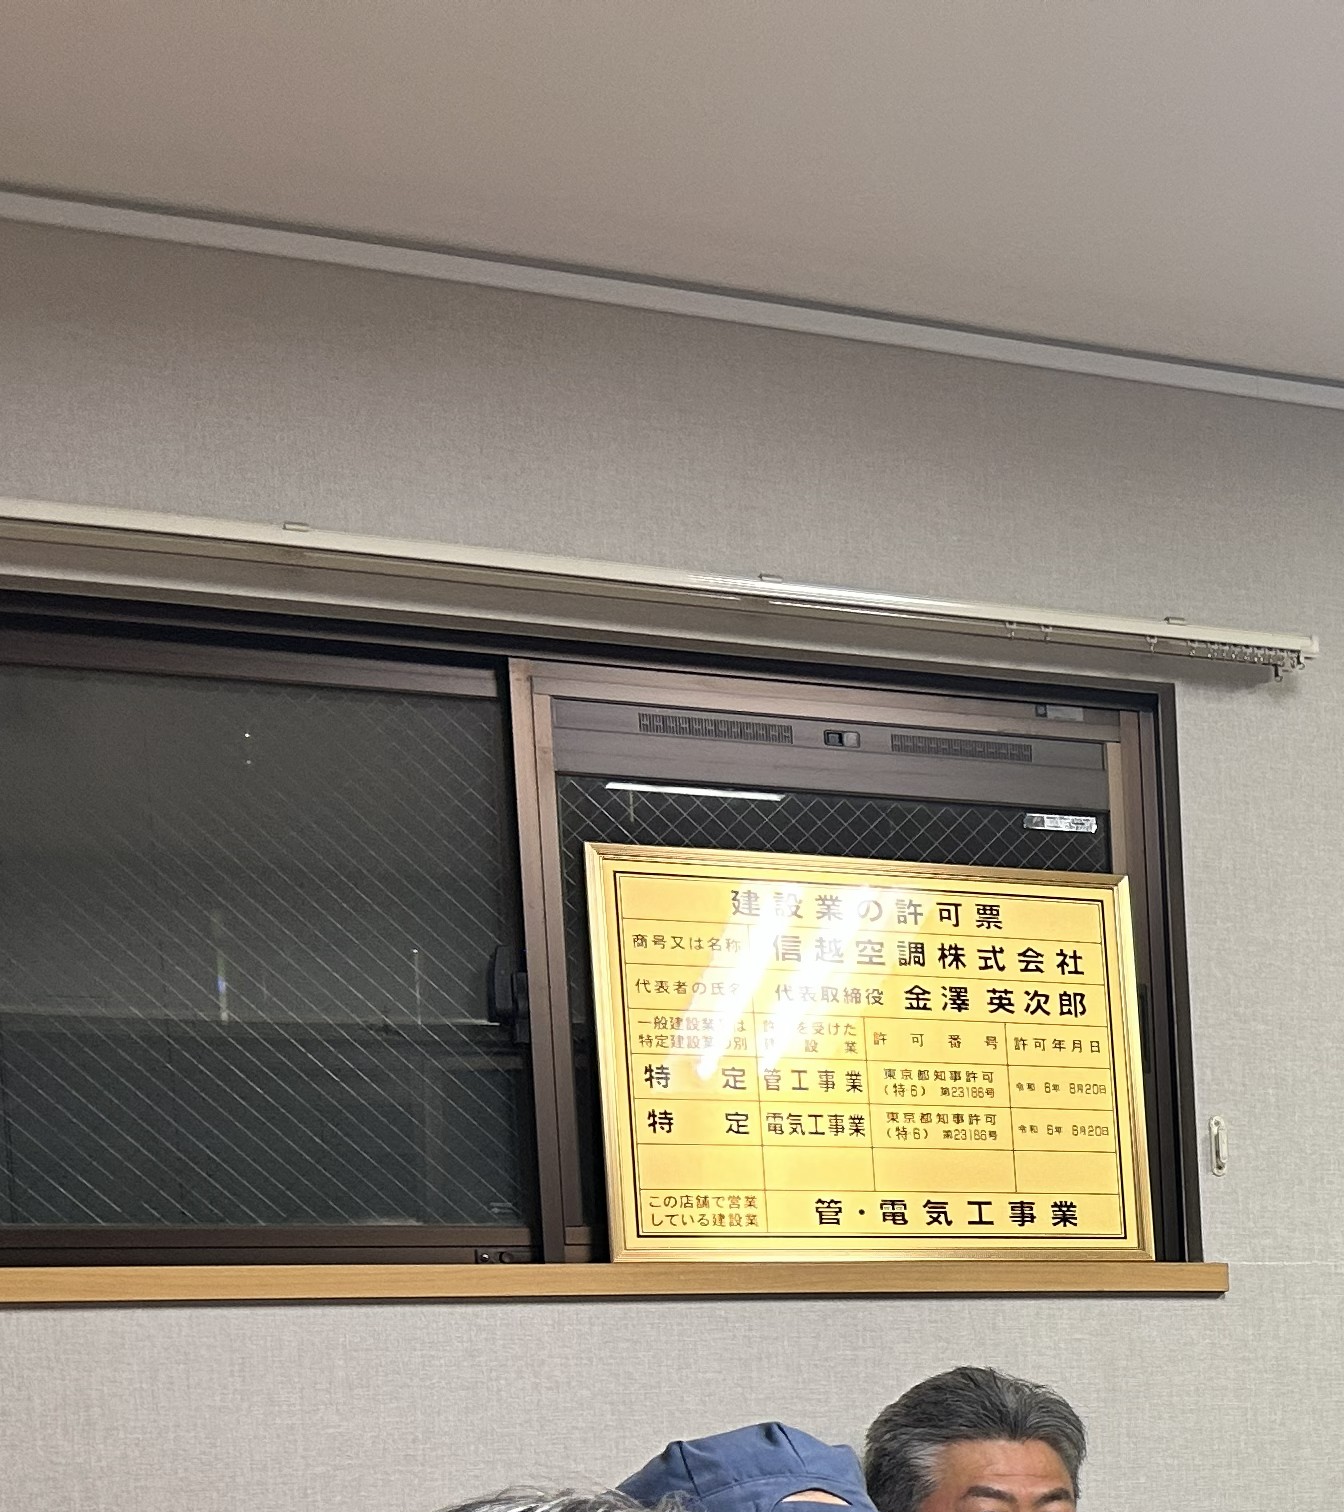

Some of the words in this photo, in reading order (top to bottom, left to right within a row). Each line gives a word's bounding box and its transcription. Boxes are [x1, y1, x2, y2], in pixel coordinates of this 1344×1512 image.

[731, 890, 1003, 930] 建設業の許可票
[632, 934, 741, 953] 商号又は名称
[773, 934, 1085, 976] 信越空調株式会社
[775, 984, 884, 1006] 代表取締役
[873, 1032, 998, 1051] 許可番号
[1014, 1036, 1101, 1054] 許可年月日
[763, 1068, 864, 1093] 管工事業
[883, 1068, 995, 1084] 東京都知事許可
[766, 1112, 867, 1137] 電気工事業
[886, 1111, 997, 1126] 東京都知事許可
[649, 1194, 759, 1210] この店舗で営業
[651, 1212, 760, 1228] している建設業
[815, 1198, 1078, 1228] 管・電気工事業
